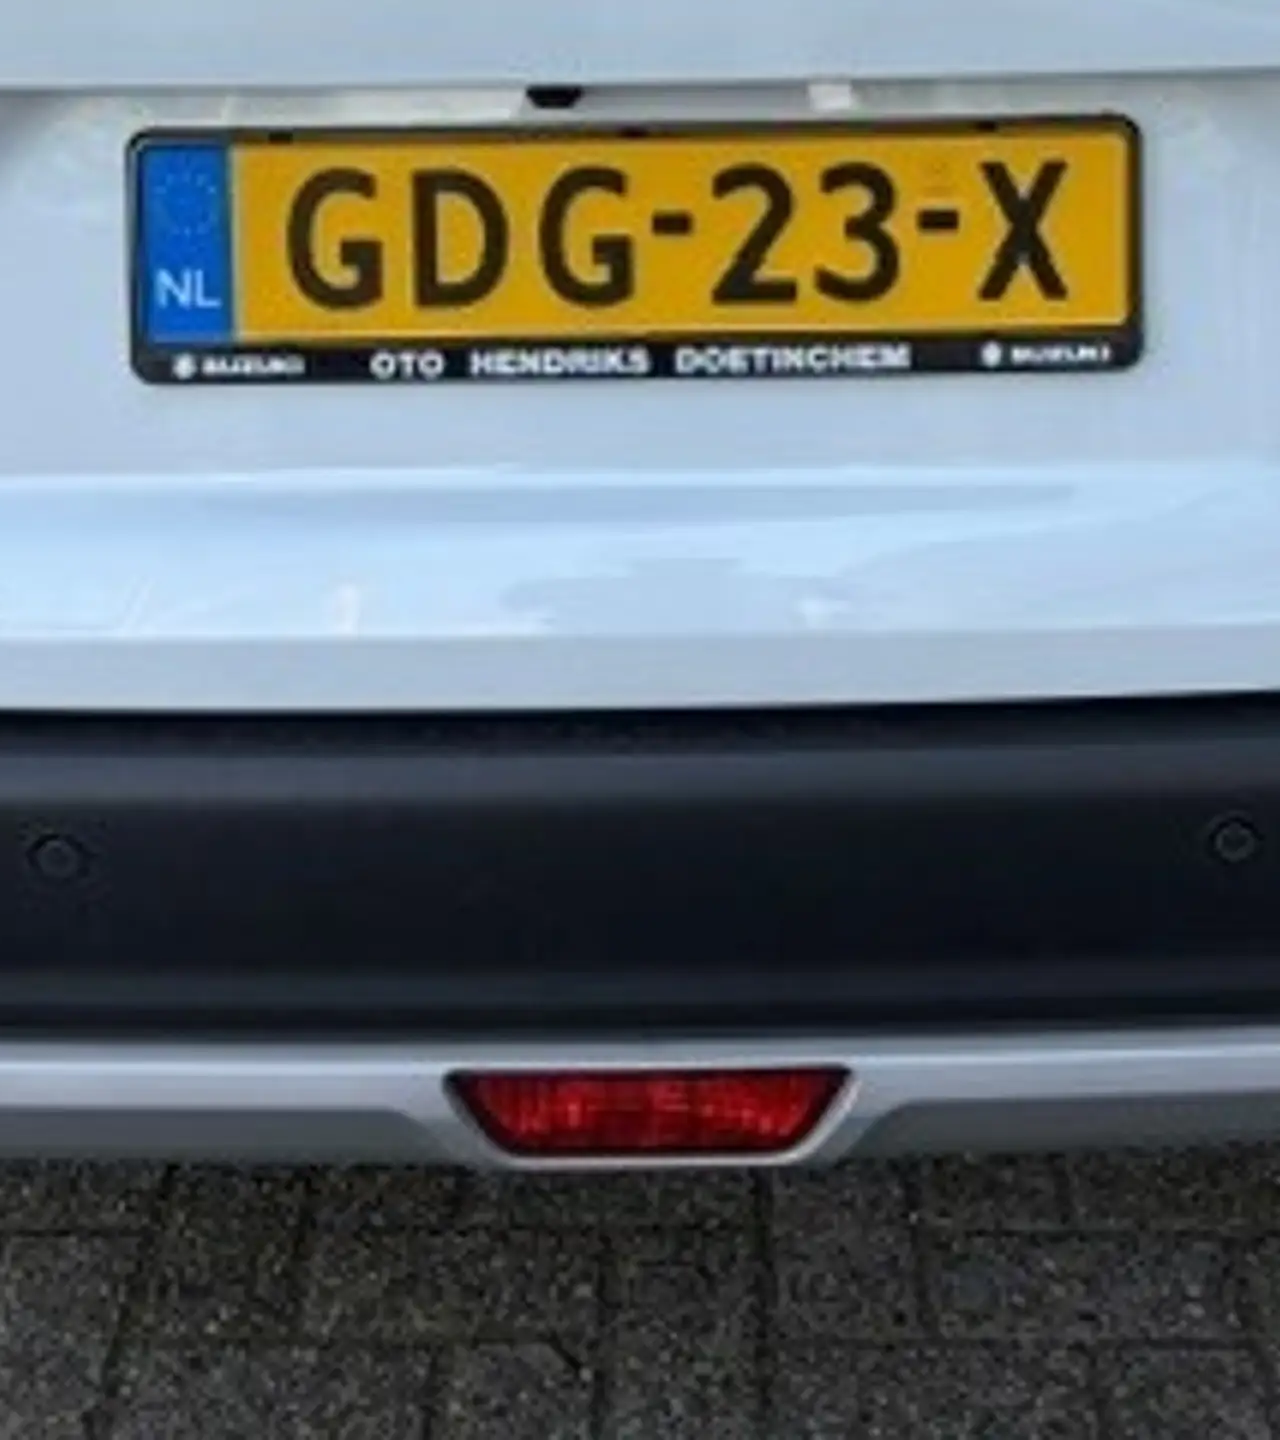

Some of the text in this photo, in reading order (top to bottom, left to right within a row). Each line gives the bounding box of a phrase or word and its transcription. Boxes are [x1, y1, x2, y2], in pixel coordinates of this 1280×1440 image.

[284, 160, 1070, 310] GDG-23-X
[155, 268, 222, 308] NL
[370, 343, 913, 379] OTO HENDRIKS DOETINCHEM
